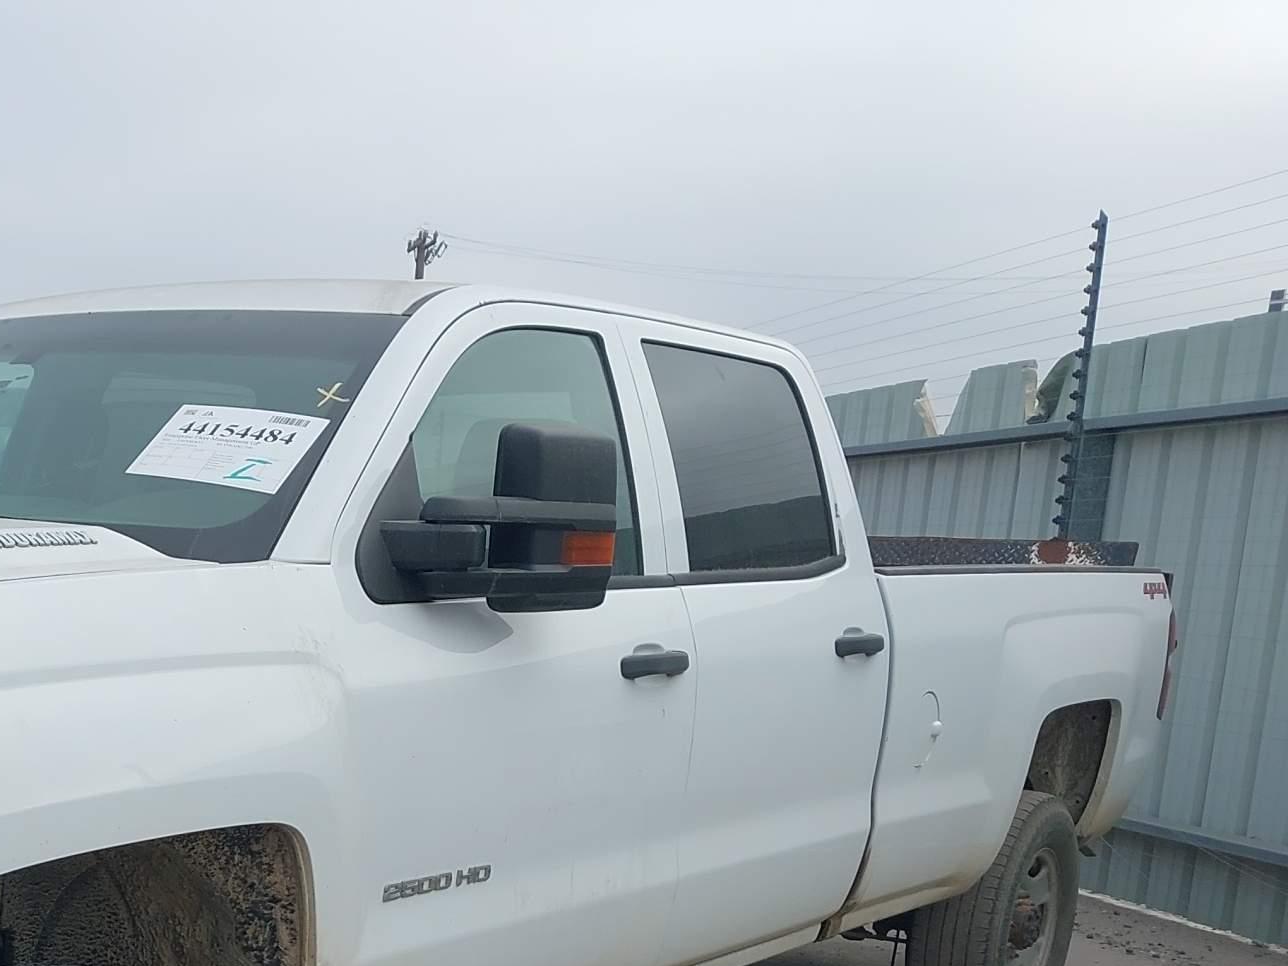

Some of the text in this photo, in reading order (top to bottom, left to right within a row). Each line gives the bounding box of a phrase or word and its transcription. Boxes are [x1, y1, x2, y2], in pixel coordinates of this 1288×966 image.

[178, 420, 298, 446] 44154484
[382, 864, 492, 903] 2500 HD
